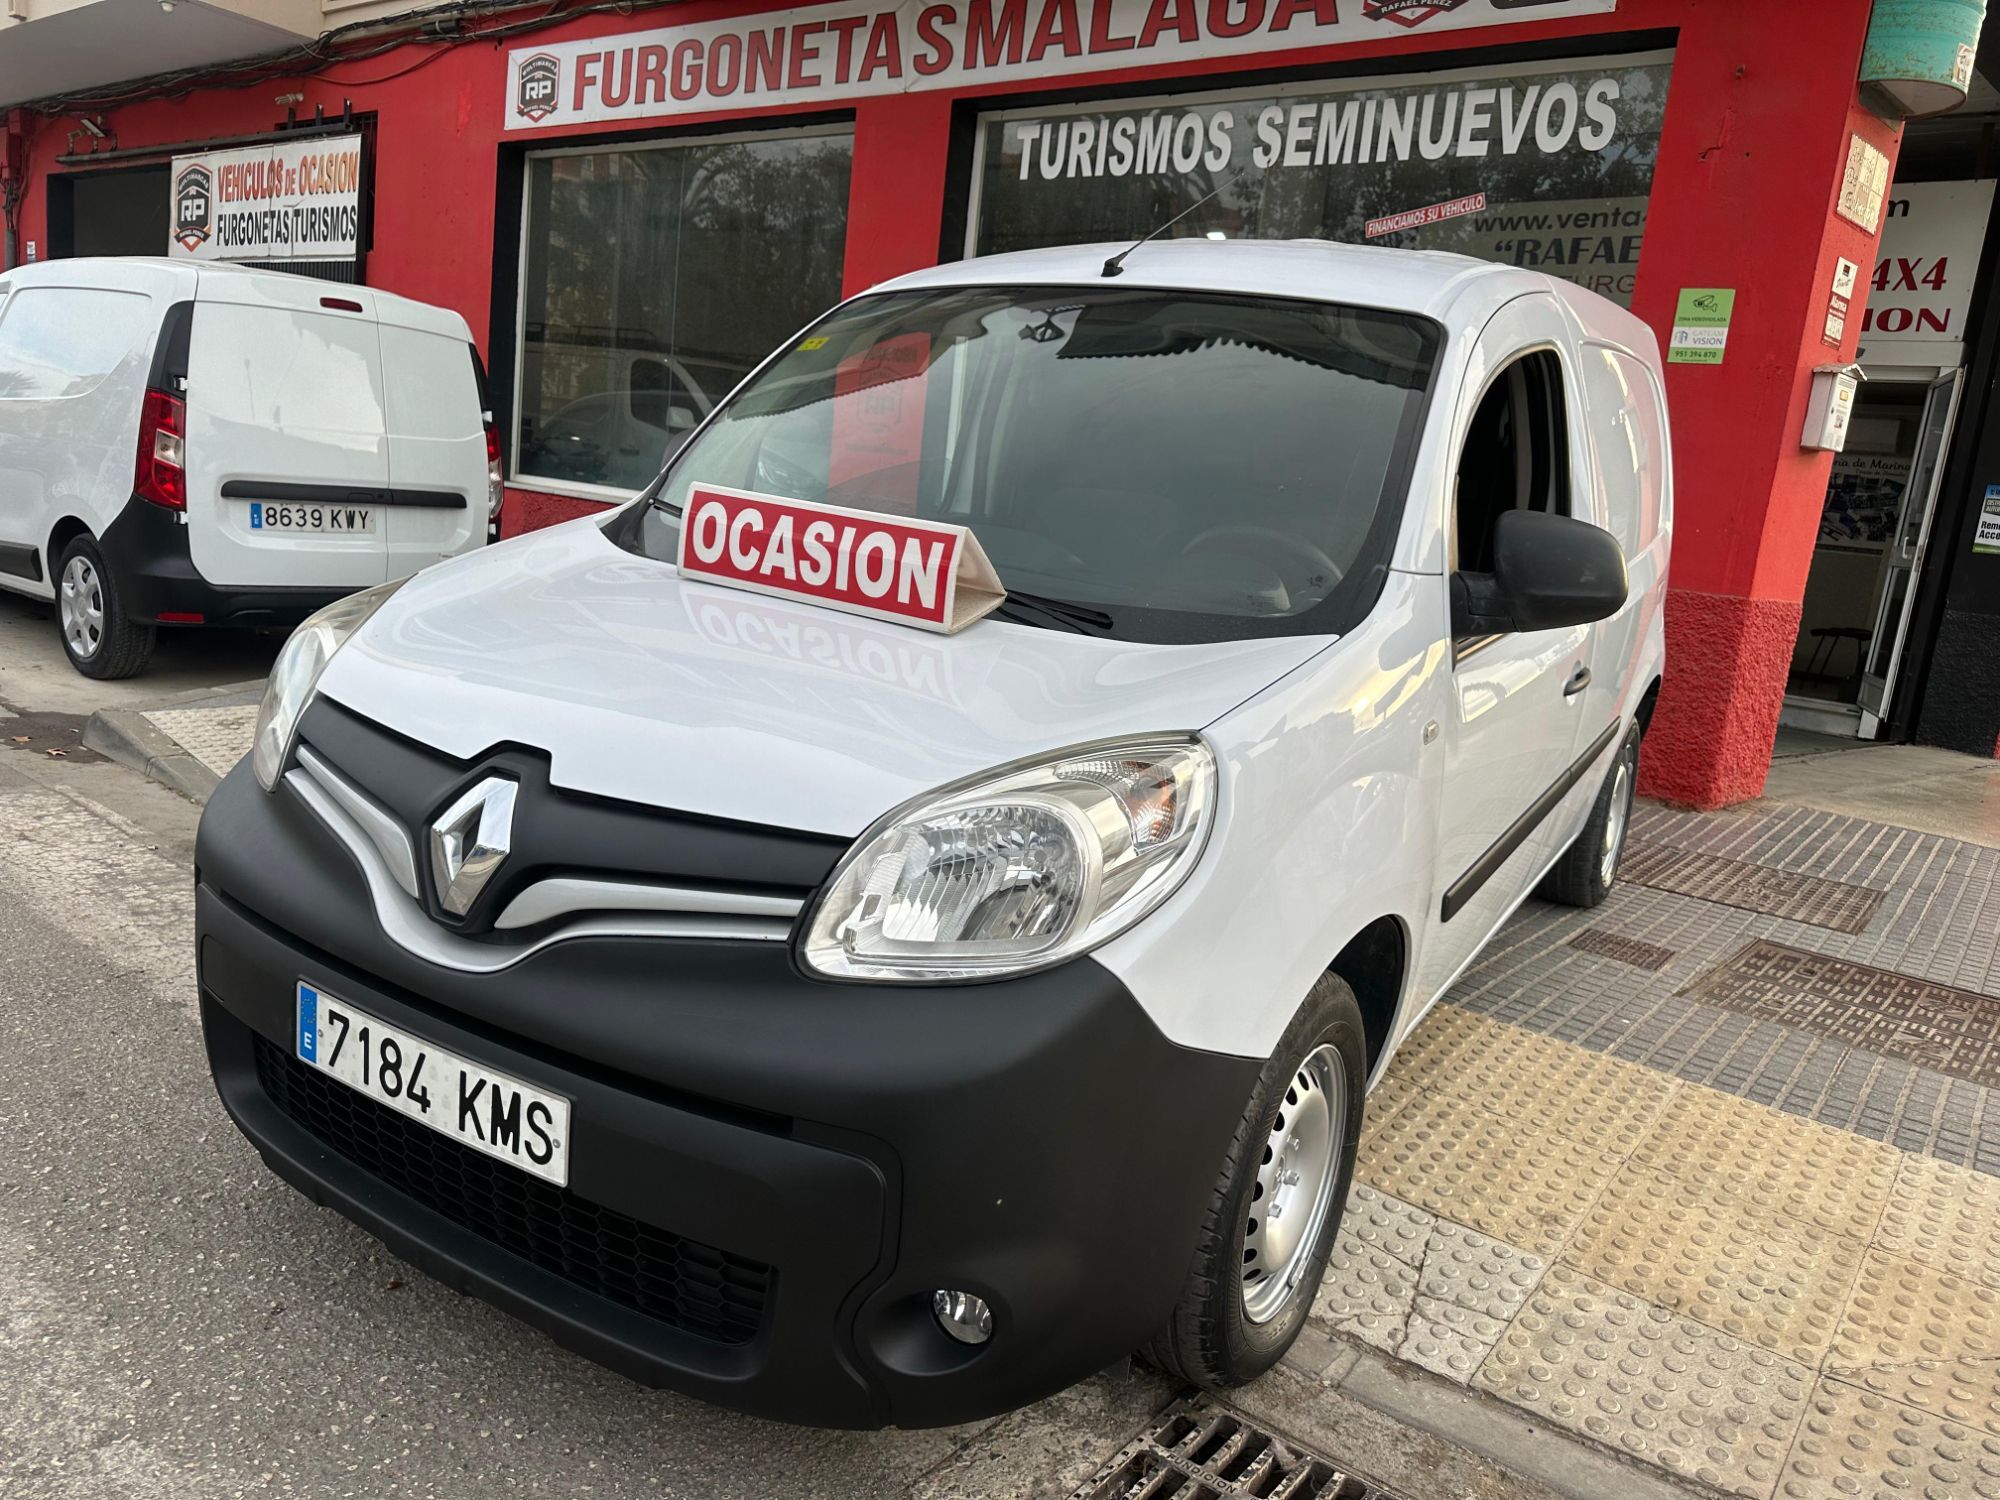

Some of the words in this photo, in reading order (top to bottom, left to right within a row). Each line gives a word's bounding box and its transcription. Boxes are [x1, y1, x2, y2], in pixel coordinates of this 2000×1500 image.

[1381, 0, 1418, 13] RAFAEL
[526, 80, 551, 100] RP
[1017, 110, 1234, 181] TURISMOS
[1253, 79, 1621, 169] SEMINUEVOS
[217, 158, 284, 202] VEHICULOS
[285, 168, 296, 195] DE
[299, 151, 359, 196] OCASION
[181, 198, 205, 222] RP
[1367, 210, 1426, 235] FINANCIAMOS
[1427, 207, 1439, 220] SU
[1440, 196, 1483, 217] VEHICULO
[1475, 207, 1647, 232] www.venta
[217, 208, 289, 246] FURGONETAS
[293, 205, 357, 243] TURISMOS
[1871, 256, 1949, 291] 4X4
[1675, 350, 1687, 358] 951
[1692, 337, 1723, 346] VISION
[265, 507, 322, 527] 8639
[331, 509, 368, 529] KWY
[692, 501, 945, 609] OCASION
[304, 1031, 313, 1050] E
[328, 1009, 431, 1114] 7184
[459, 1070, 553, 1165] KMS
